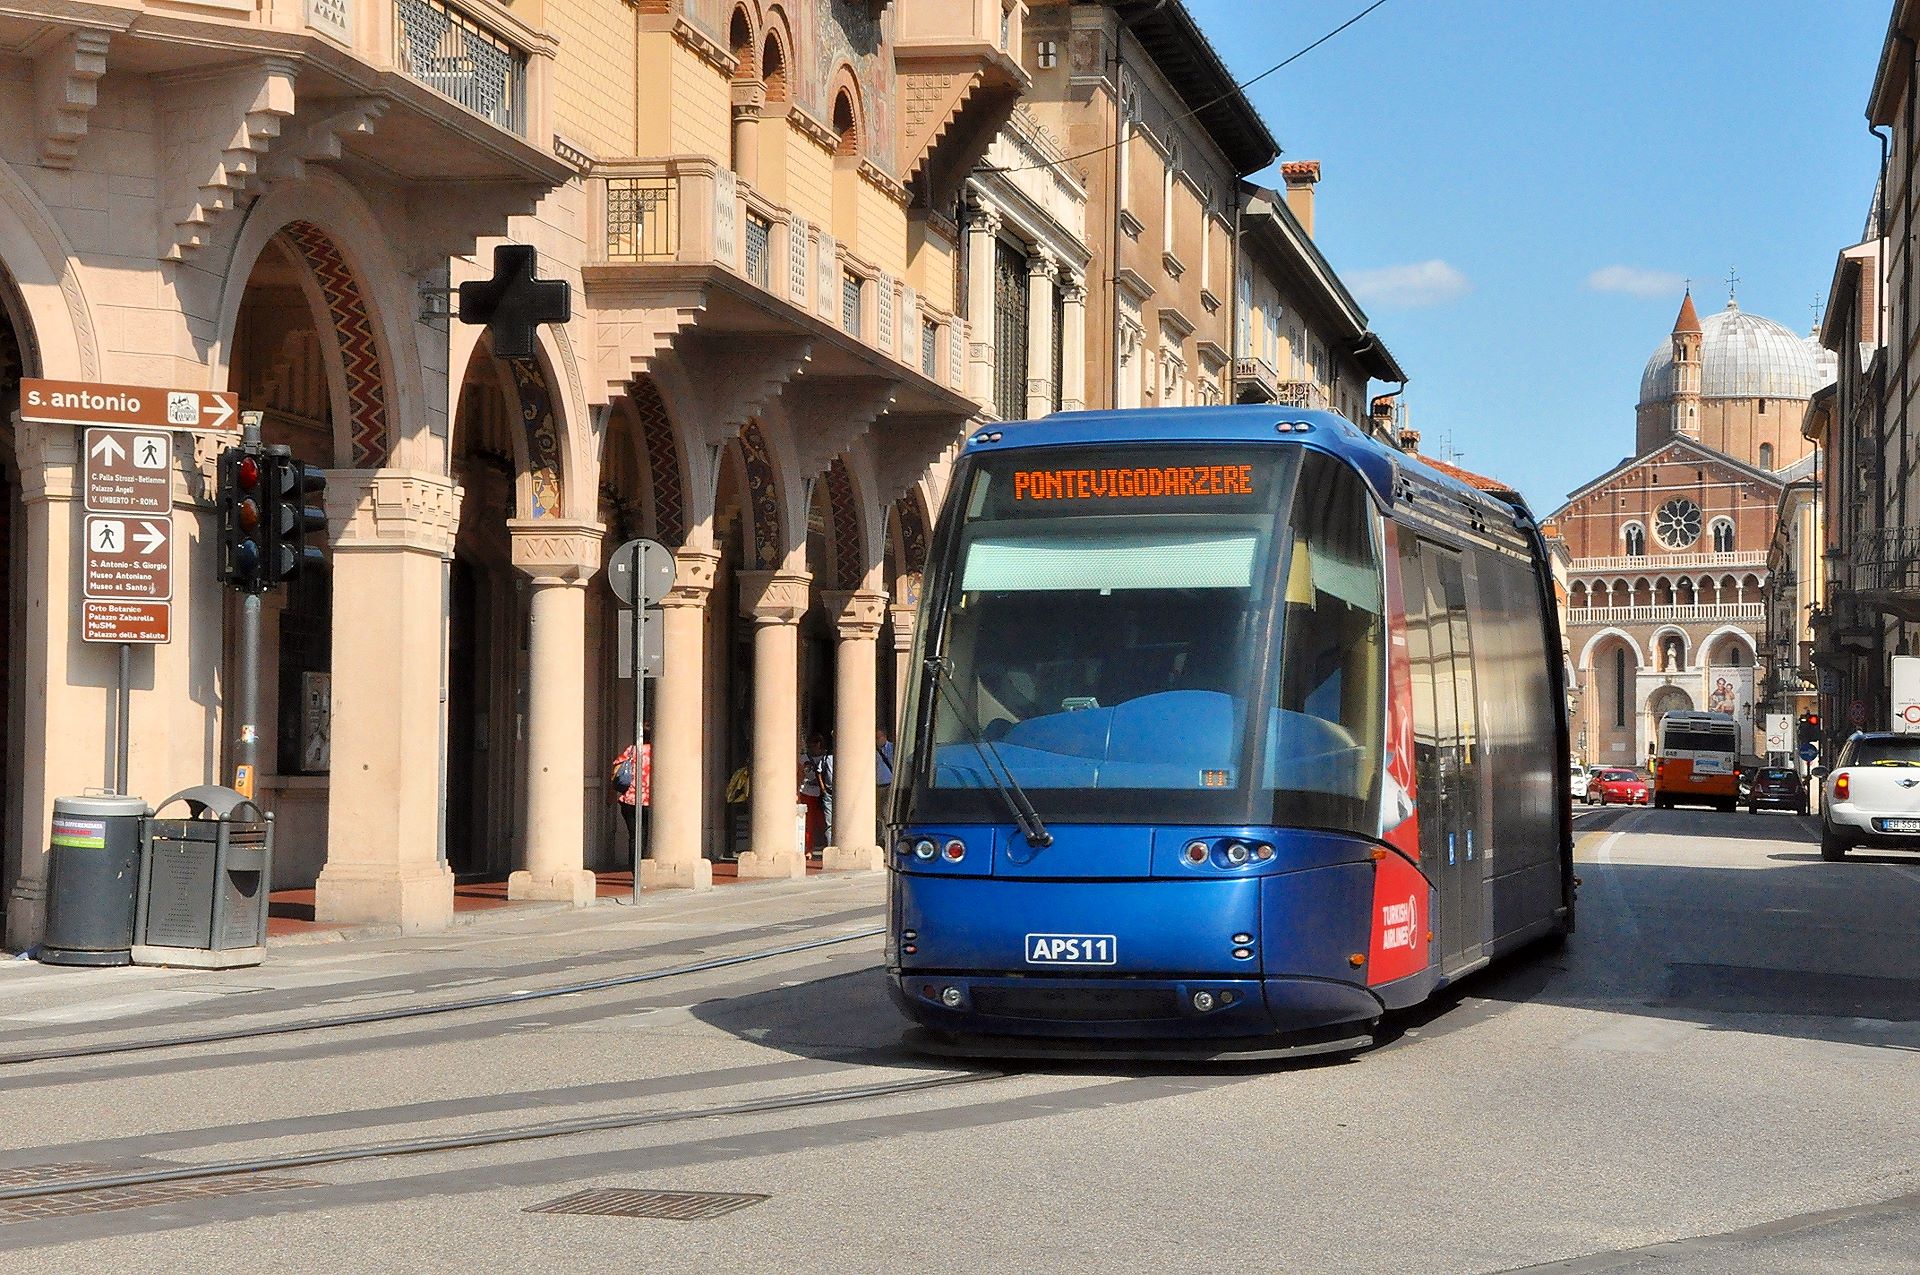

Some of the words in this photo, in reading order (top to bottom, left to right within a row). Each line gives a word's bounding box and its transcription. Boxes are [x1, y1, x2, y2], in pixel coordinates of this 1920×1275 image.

[27, 390, 47, 406] s.
[51, 391, 141, 413] antonio
[1014, 464, 1253, 500] PONTEVIGODARZERE
[91, 484, 114, 492] Palazzo
[115, 485, 134, 494] Angeli
[139, 498, 158, 506] ROMA
[100, 560, 128, 568] Antonio
[142, 562, 167, 571] Giorgio
[115, 571, 152, 580] Antoniano
[90, 582, 113, 590] Museo
[125, 583, 147, 591] Santo
[89, 604, 107, 612] Orto
[108, 605, 141, 613] Botanico
[119, 613, 154, 621] Zabarella
[88, 630, 117, 638] Palazzo
[140, 631, 165, 639] Salute
[1382, 902, 1409, 927] TURKISH
[1382, 925, 1409, 950] AIRLINES
[1032, 938, 1107, 960] APS11
